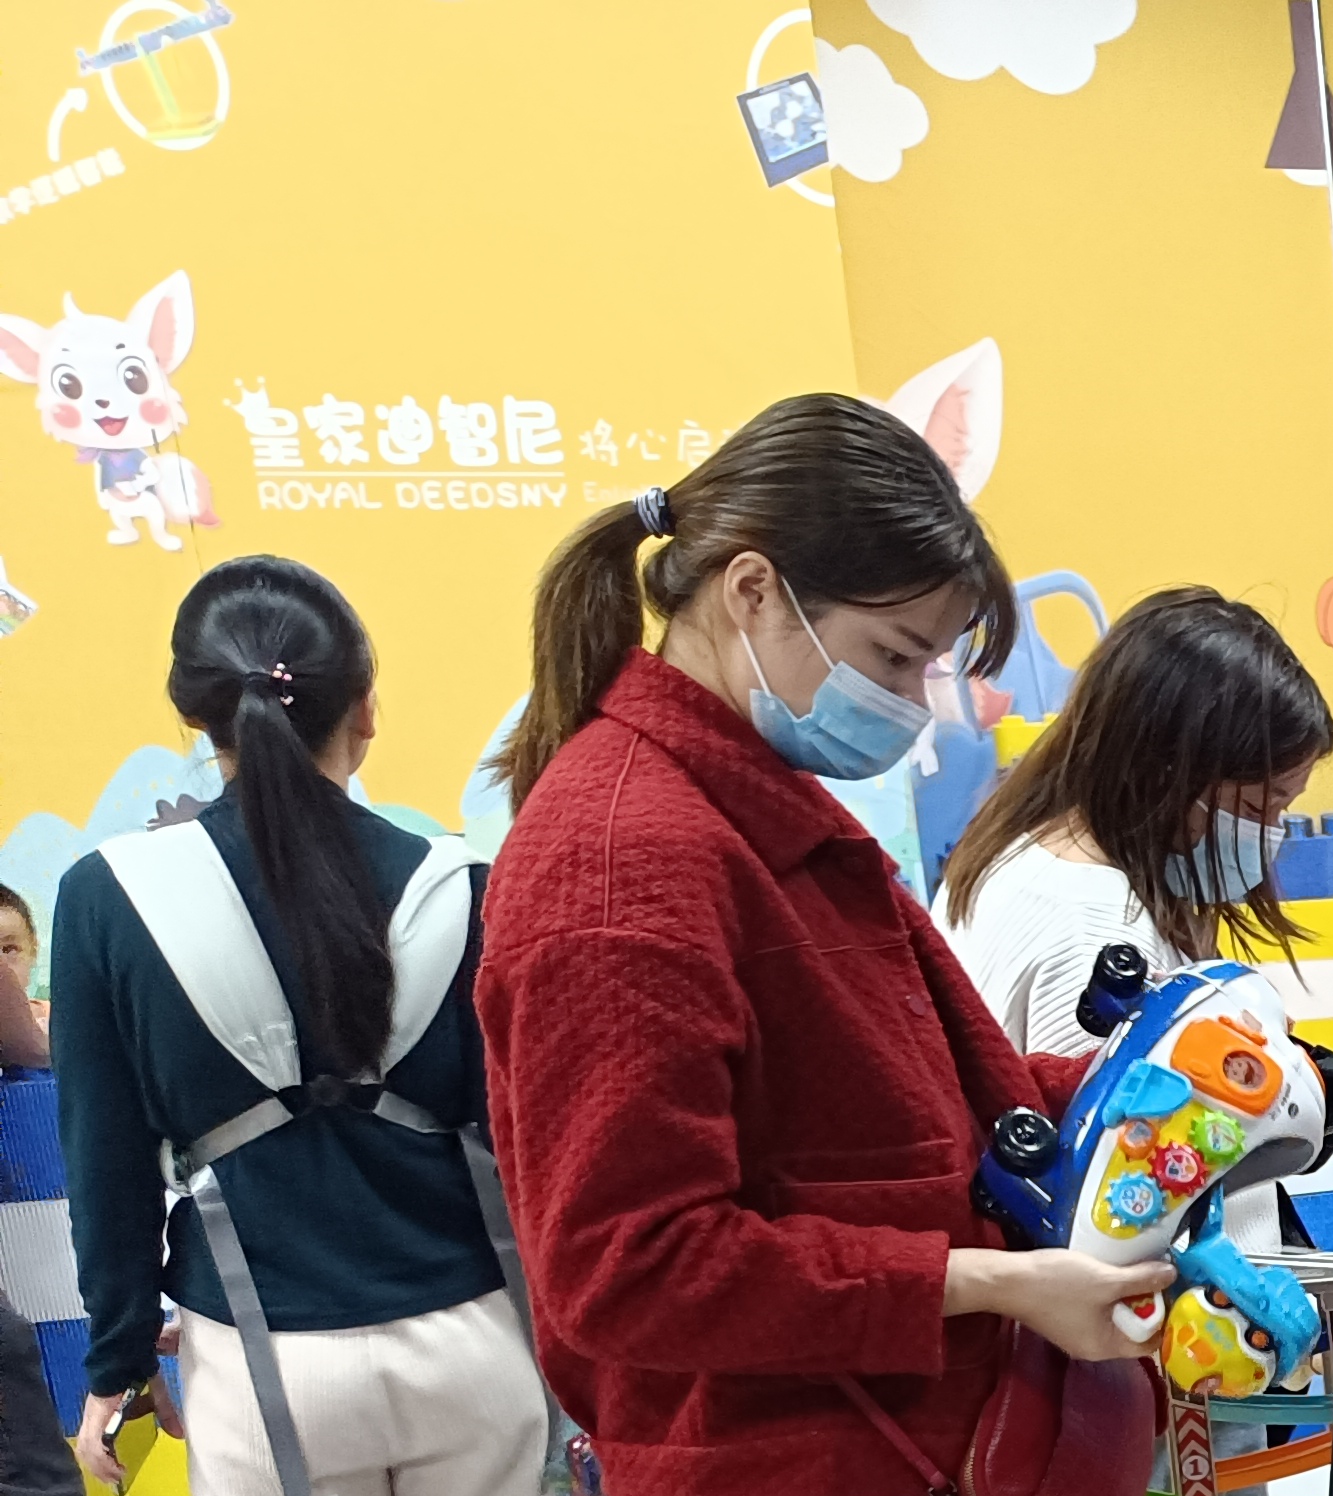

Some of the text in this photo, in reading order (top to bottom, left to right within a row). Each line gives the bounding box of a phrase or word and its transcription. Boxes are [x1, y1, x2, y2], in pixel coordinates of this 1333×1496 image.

[238, 386, 565, 467] 皇家迪智尼
[257, 479, 383, 511] ROYAL
[395, 479, 568, 511] DEEDSNY
[1189, 1458, 1203, 1476] 1
